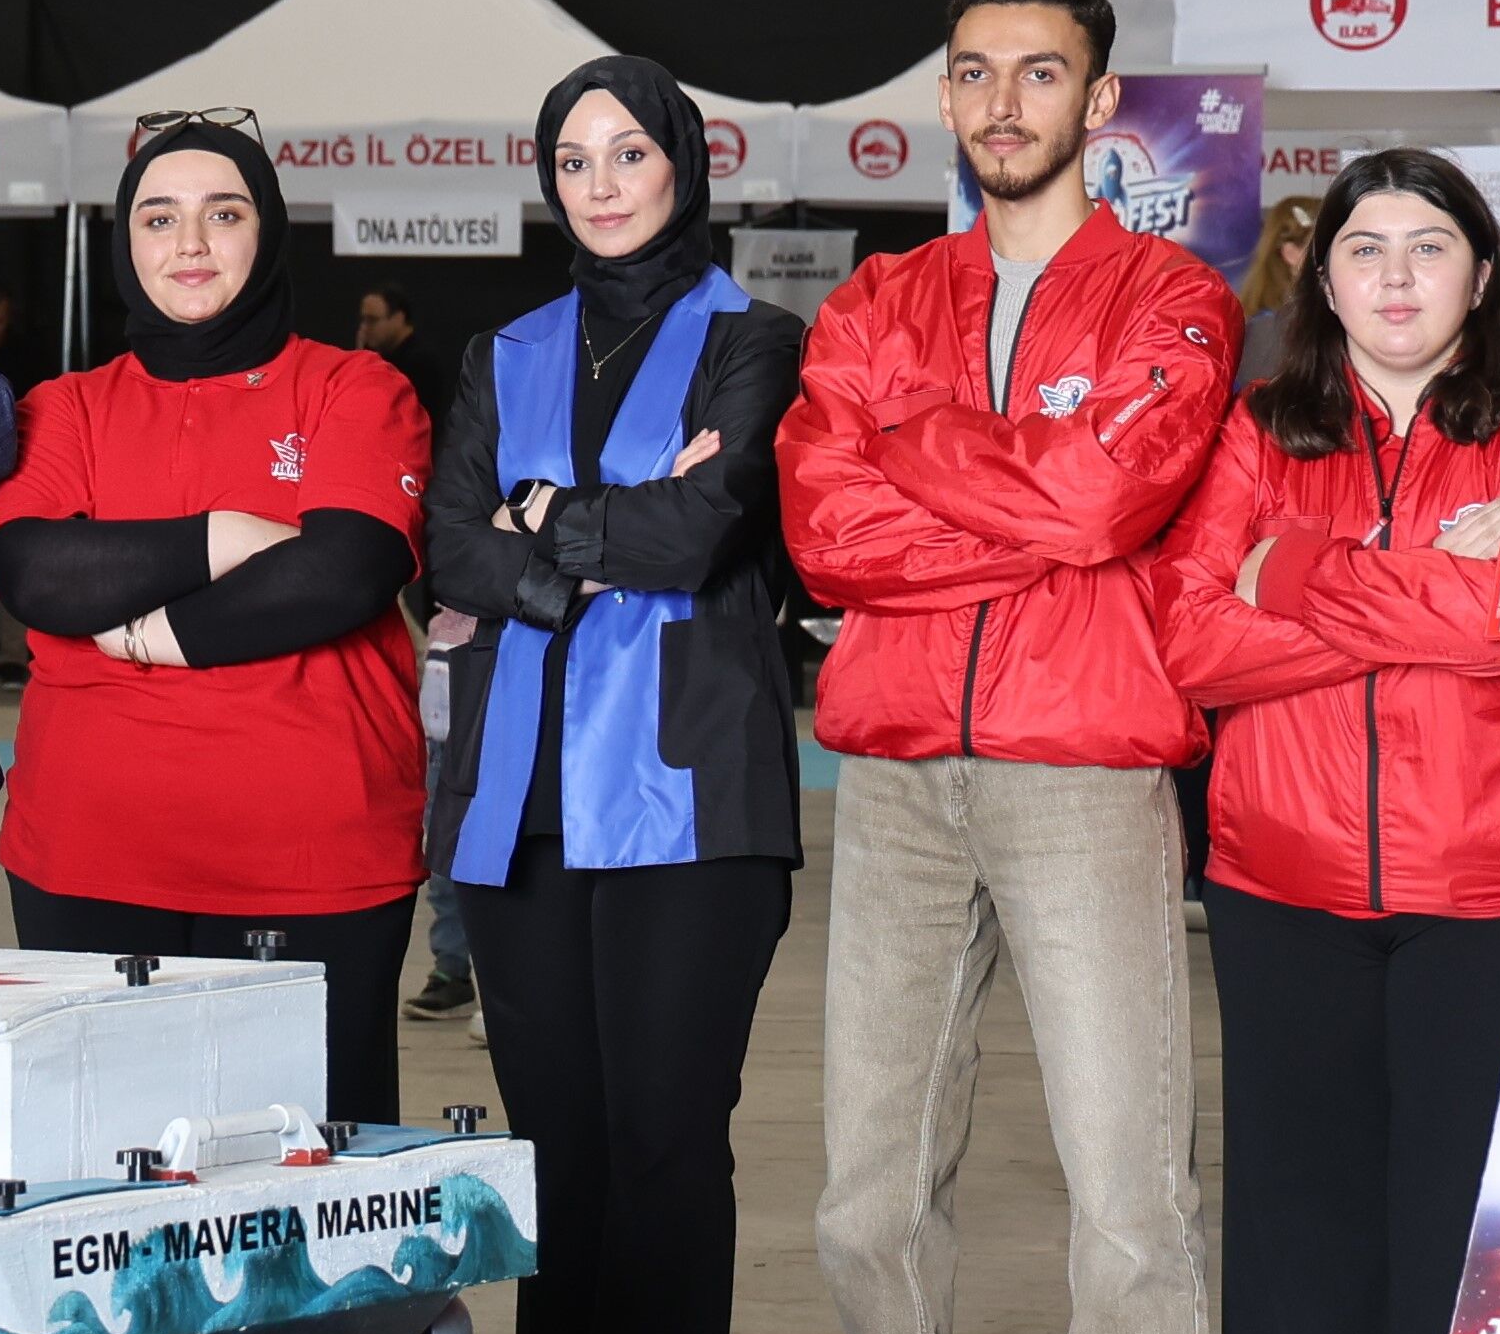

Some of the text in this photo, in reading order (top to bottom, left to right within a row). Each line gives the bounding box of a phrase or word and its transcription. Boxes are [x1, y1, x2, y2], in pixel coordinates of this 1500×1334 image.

[274, 133, 356, 167] AZIĞ
[366, 134, 397, 166] İL
[405, 133, 495, 166] ÖZEL
[356, 213, 499, 246] DNA ATÖLYESİ
[52, 1229, 131, 1279] EGM
[163, 1205, 306, 1264] MAVERA
[317, 1185, 442, 1240] MARINE
